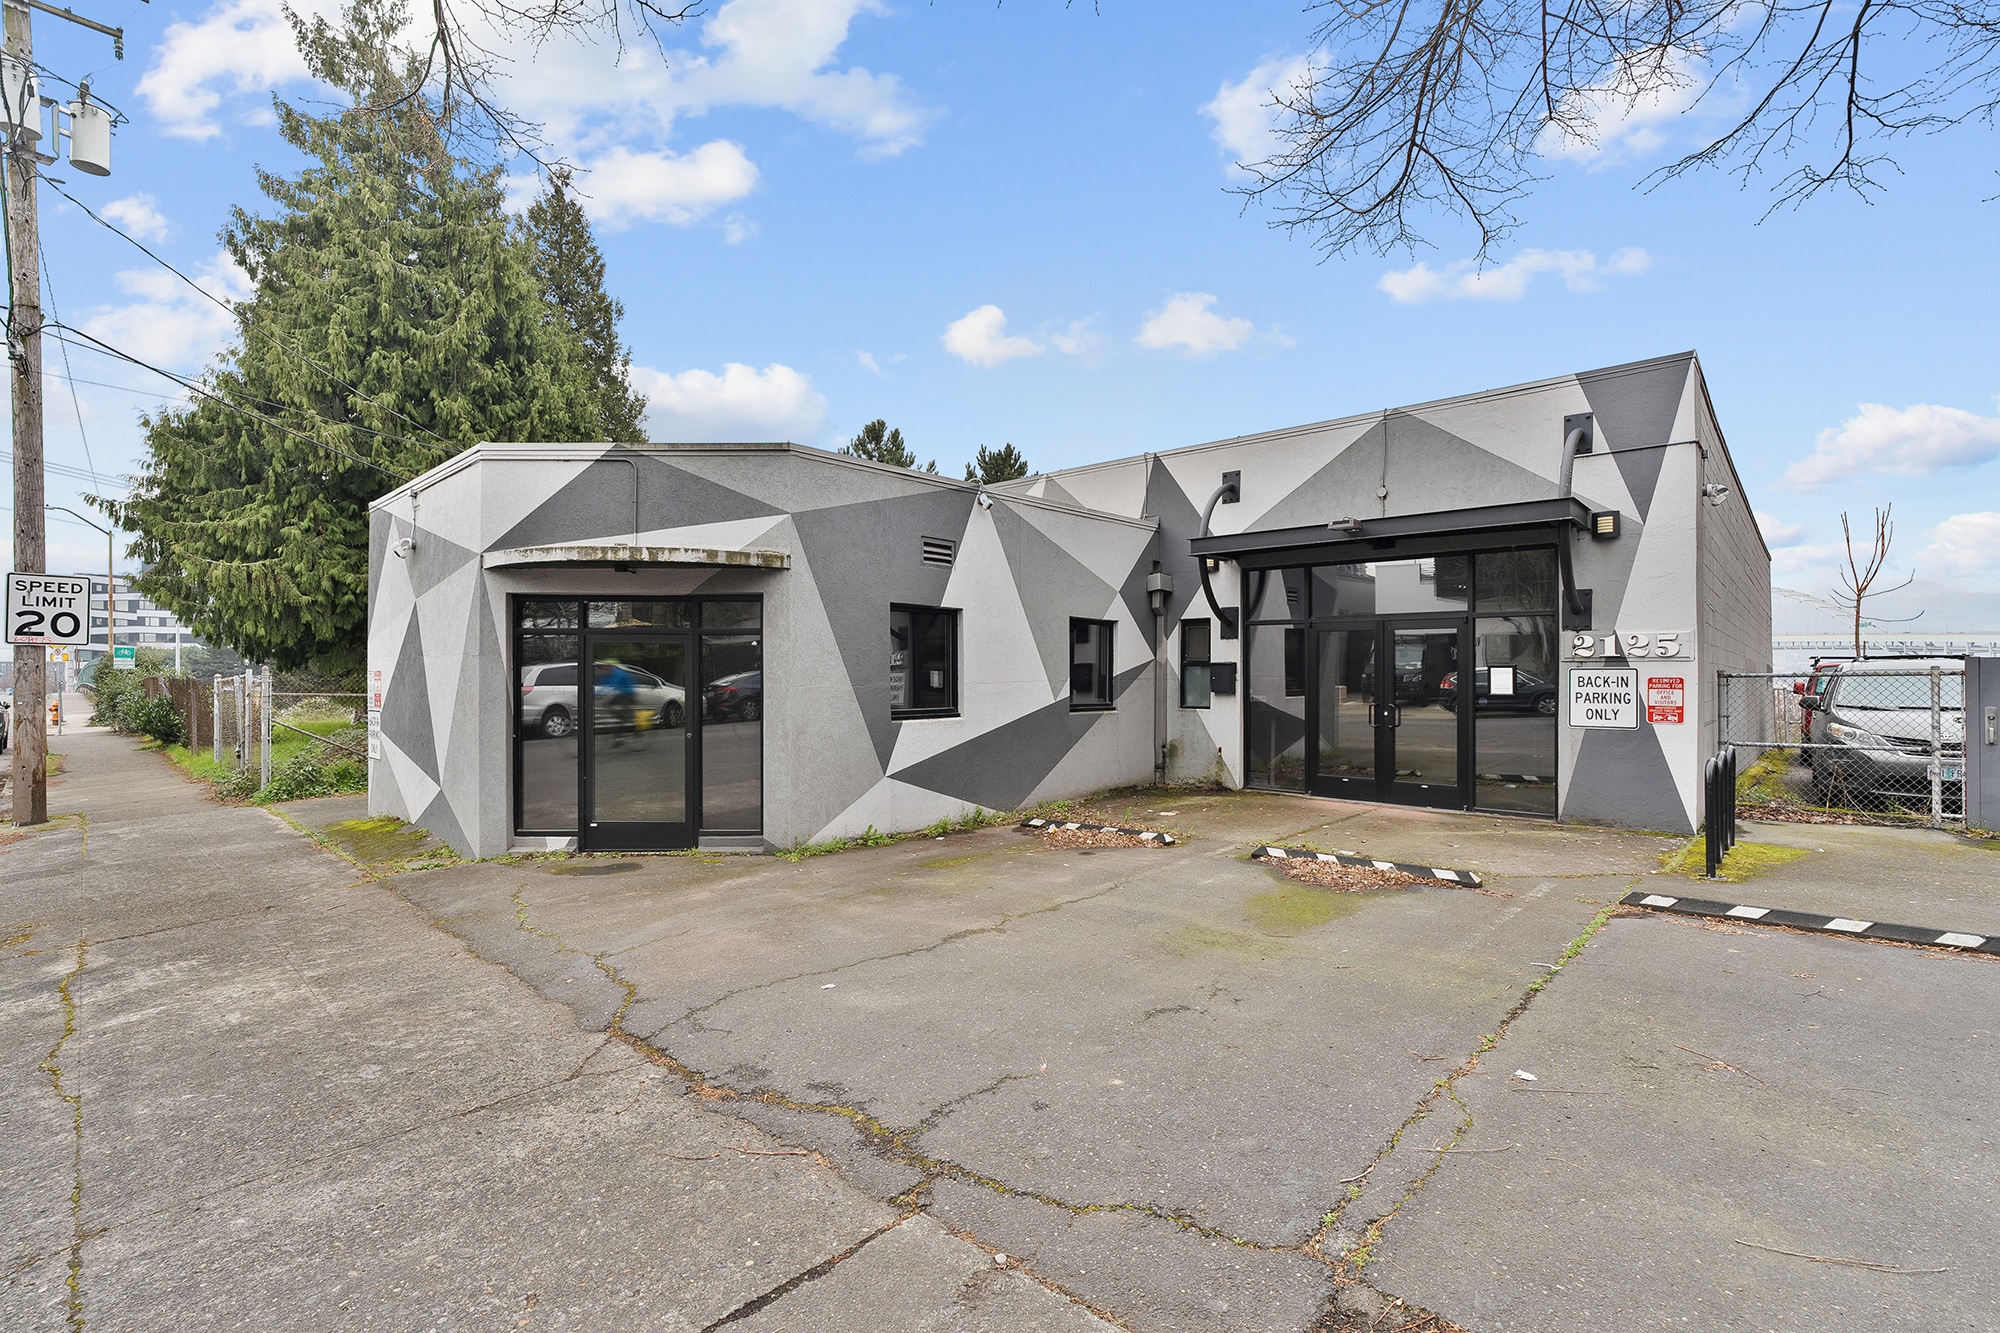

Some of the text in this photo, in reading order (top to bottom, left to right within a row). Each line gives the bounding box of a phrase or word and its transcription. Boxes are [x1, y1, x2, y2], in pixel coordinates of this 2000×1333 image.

[15, 580, 83, 594] SPEED
[22, 595, 76, 608] LIMIT
[14, 610, 81, 638] 20
[1572, 634, 1681, 658] 2125
[1577, 676, 1629, 688] BACK-IN
[1575, 692, 1631, 705] PARKING
[1585, 708, 1620, 721] ONLY
